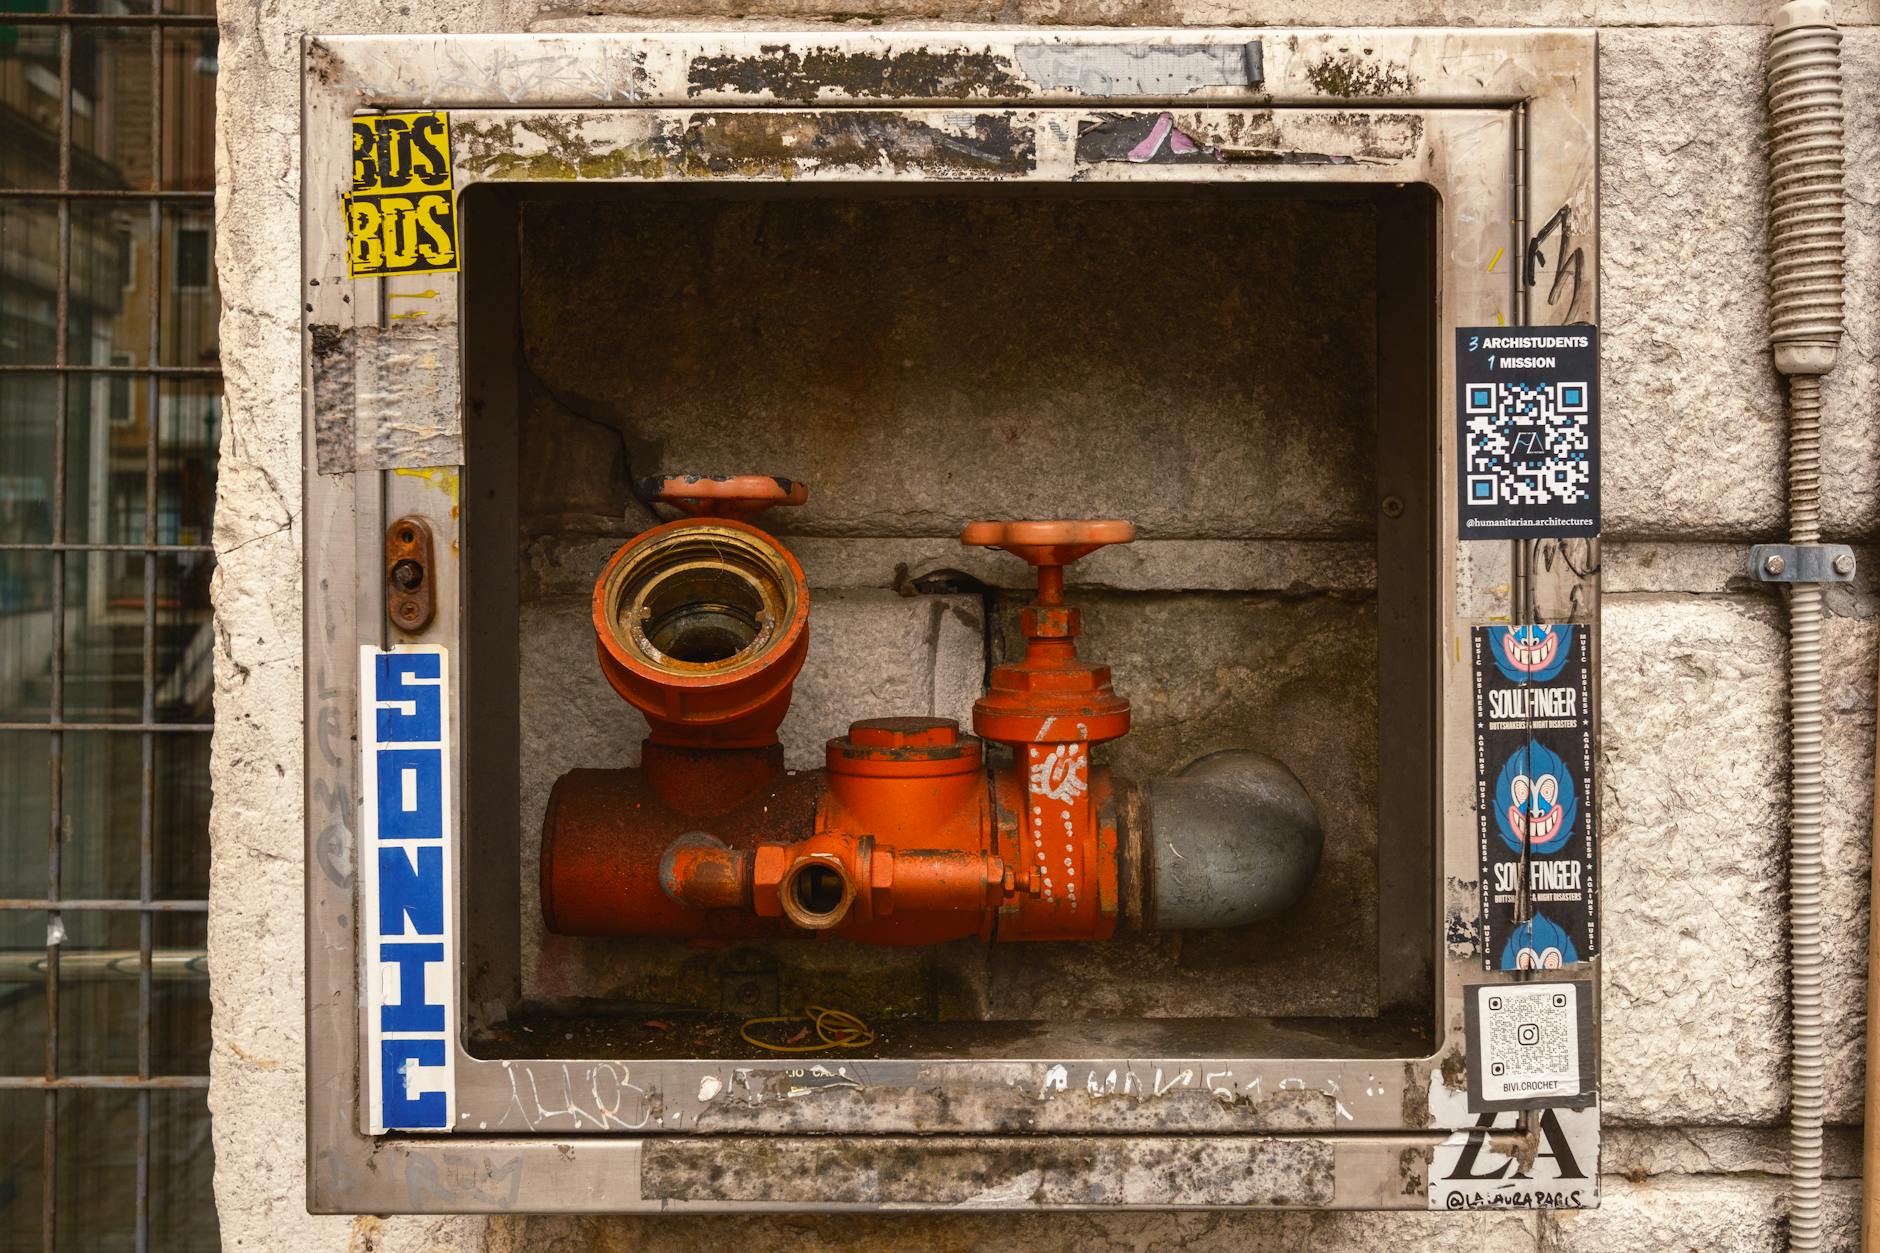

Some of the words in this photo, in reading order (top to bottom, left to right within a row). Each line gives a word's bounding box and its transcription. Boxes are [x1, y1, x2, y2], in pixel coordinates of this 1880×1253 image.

[351, 194, 455, 271] BDS
[1469, 336, 1479, 352] 3
[1482, 336, 1589, 349] ARCHISTUDENTS
[1488, 355, 1496, 371] 1
[1500, 357, 1556, 369] MISSION
[1466, 517, 1593, 528] @humanitarian.architectures
[1474, 637, 1482, 666] MUSIC
[1488, 687, 1577, 719] SOULFINGER
[1548, 719, 1578, 729] DISASTERS
[375, 653, 447, 1128] SONIC
[1553, 892, 1582, 902] DISASTERS
[1503, 1080, 1558, 1092] BIVI.CROCHET
